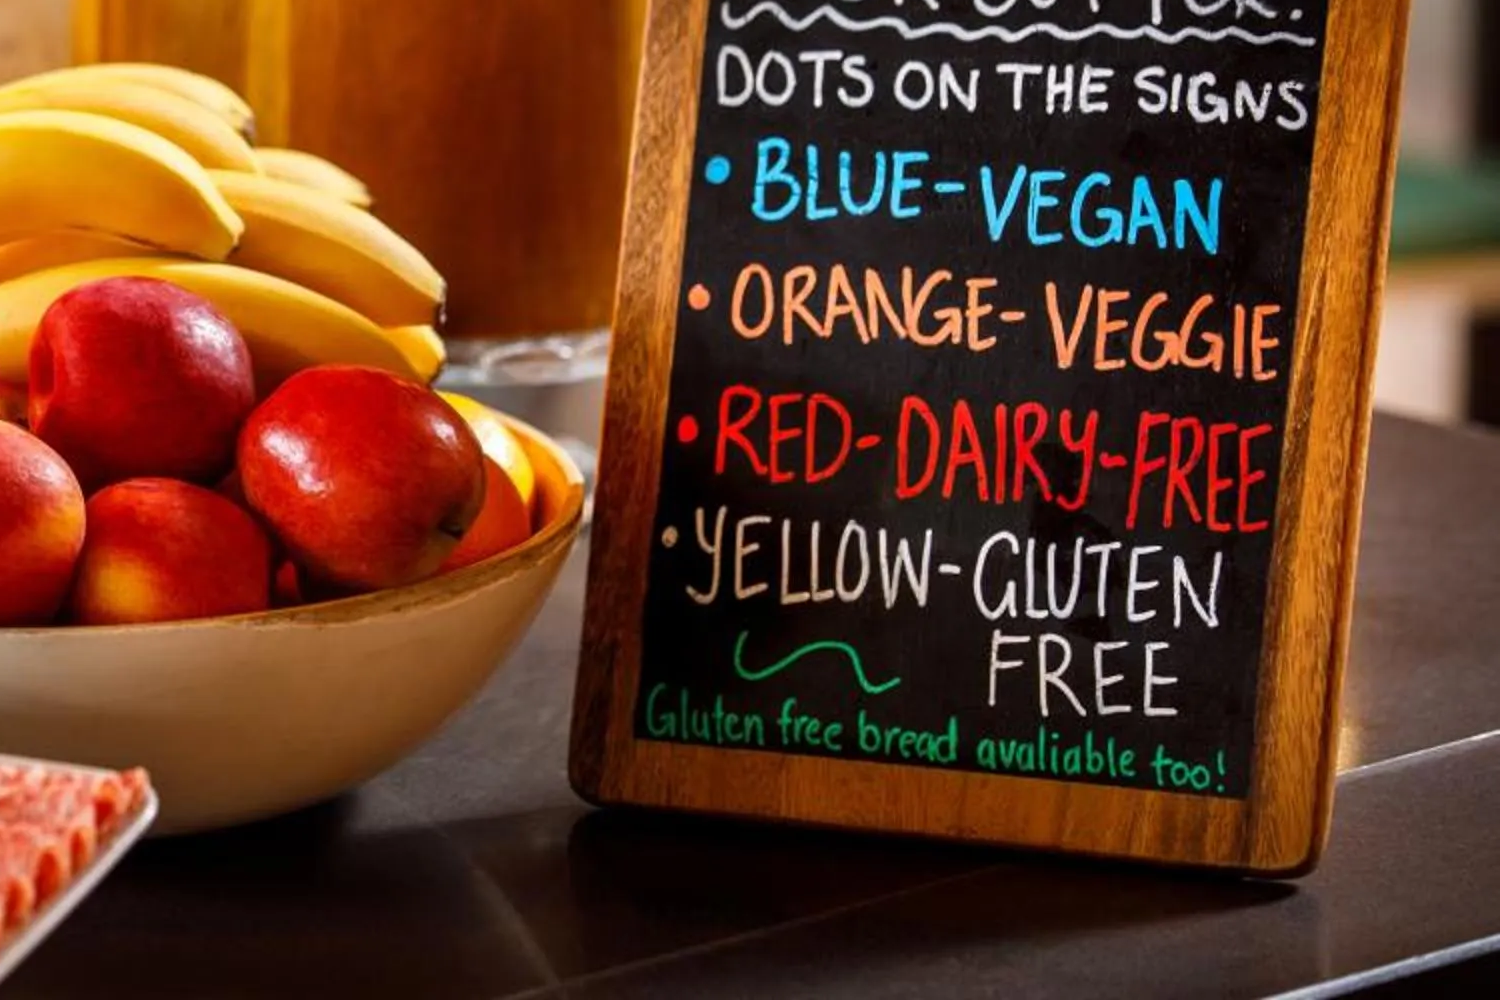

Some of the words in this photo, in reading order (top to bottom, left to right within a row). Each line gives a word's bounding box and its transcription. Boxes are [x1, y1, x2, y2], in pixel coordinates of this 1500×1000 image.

[715, 43, 876, 110] DOTS
[892, 59, 982, 114] ON
[994, 61, 1116, 116] THE
[1133, 64, 1309, 131] SIGNS
[987, 627, 1180, 718] FREE
[646, 682, 765, 746] Gluten
[777, 697, 843, 751] free
[858, 709, 958, 763] bread
[976, 724, 1137, 778] avaliable
[1151, 744, 1226, 793] too!
